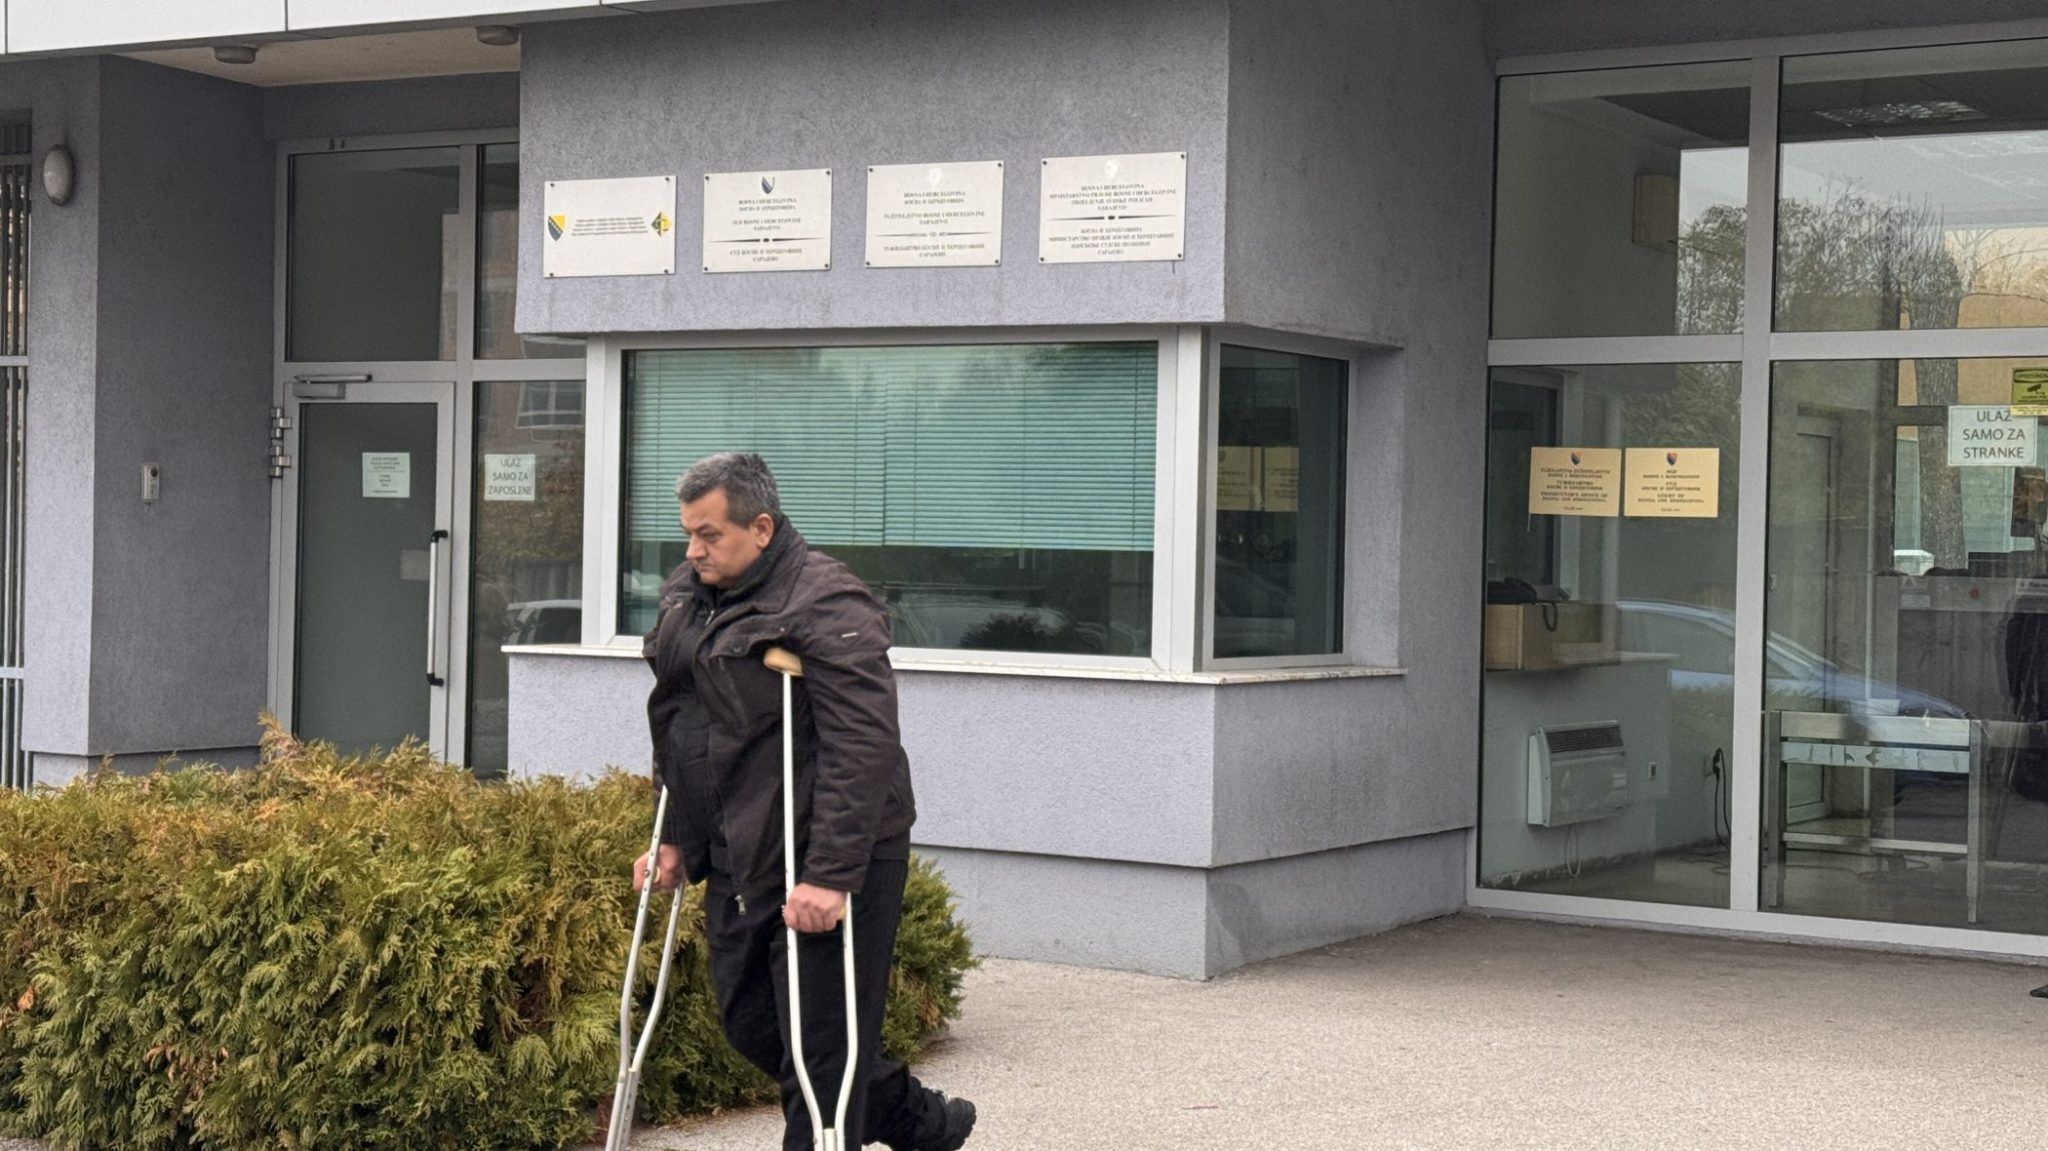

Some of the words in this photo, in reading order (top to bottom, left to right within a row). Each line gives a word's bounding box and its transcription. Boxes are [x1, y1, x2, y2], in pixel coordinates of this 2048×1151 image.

[1976, 410, 2012, 422] ULAZ
[1962, 428, 2004, 440] SAMO
[2007, 428, 2026, 440] ZA
[1963, 446, 2024, 459] STRANKE
[500, 457, 522, 468] ULAZ
[492, 472, 516, 481] SAMO
[518, 472, 528, 481] ZA
[488, 486, 532, 496] ZAPOSLENE
